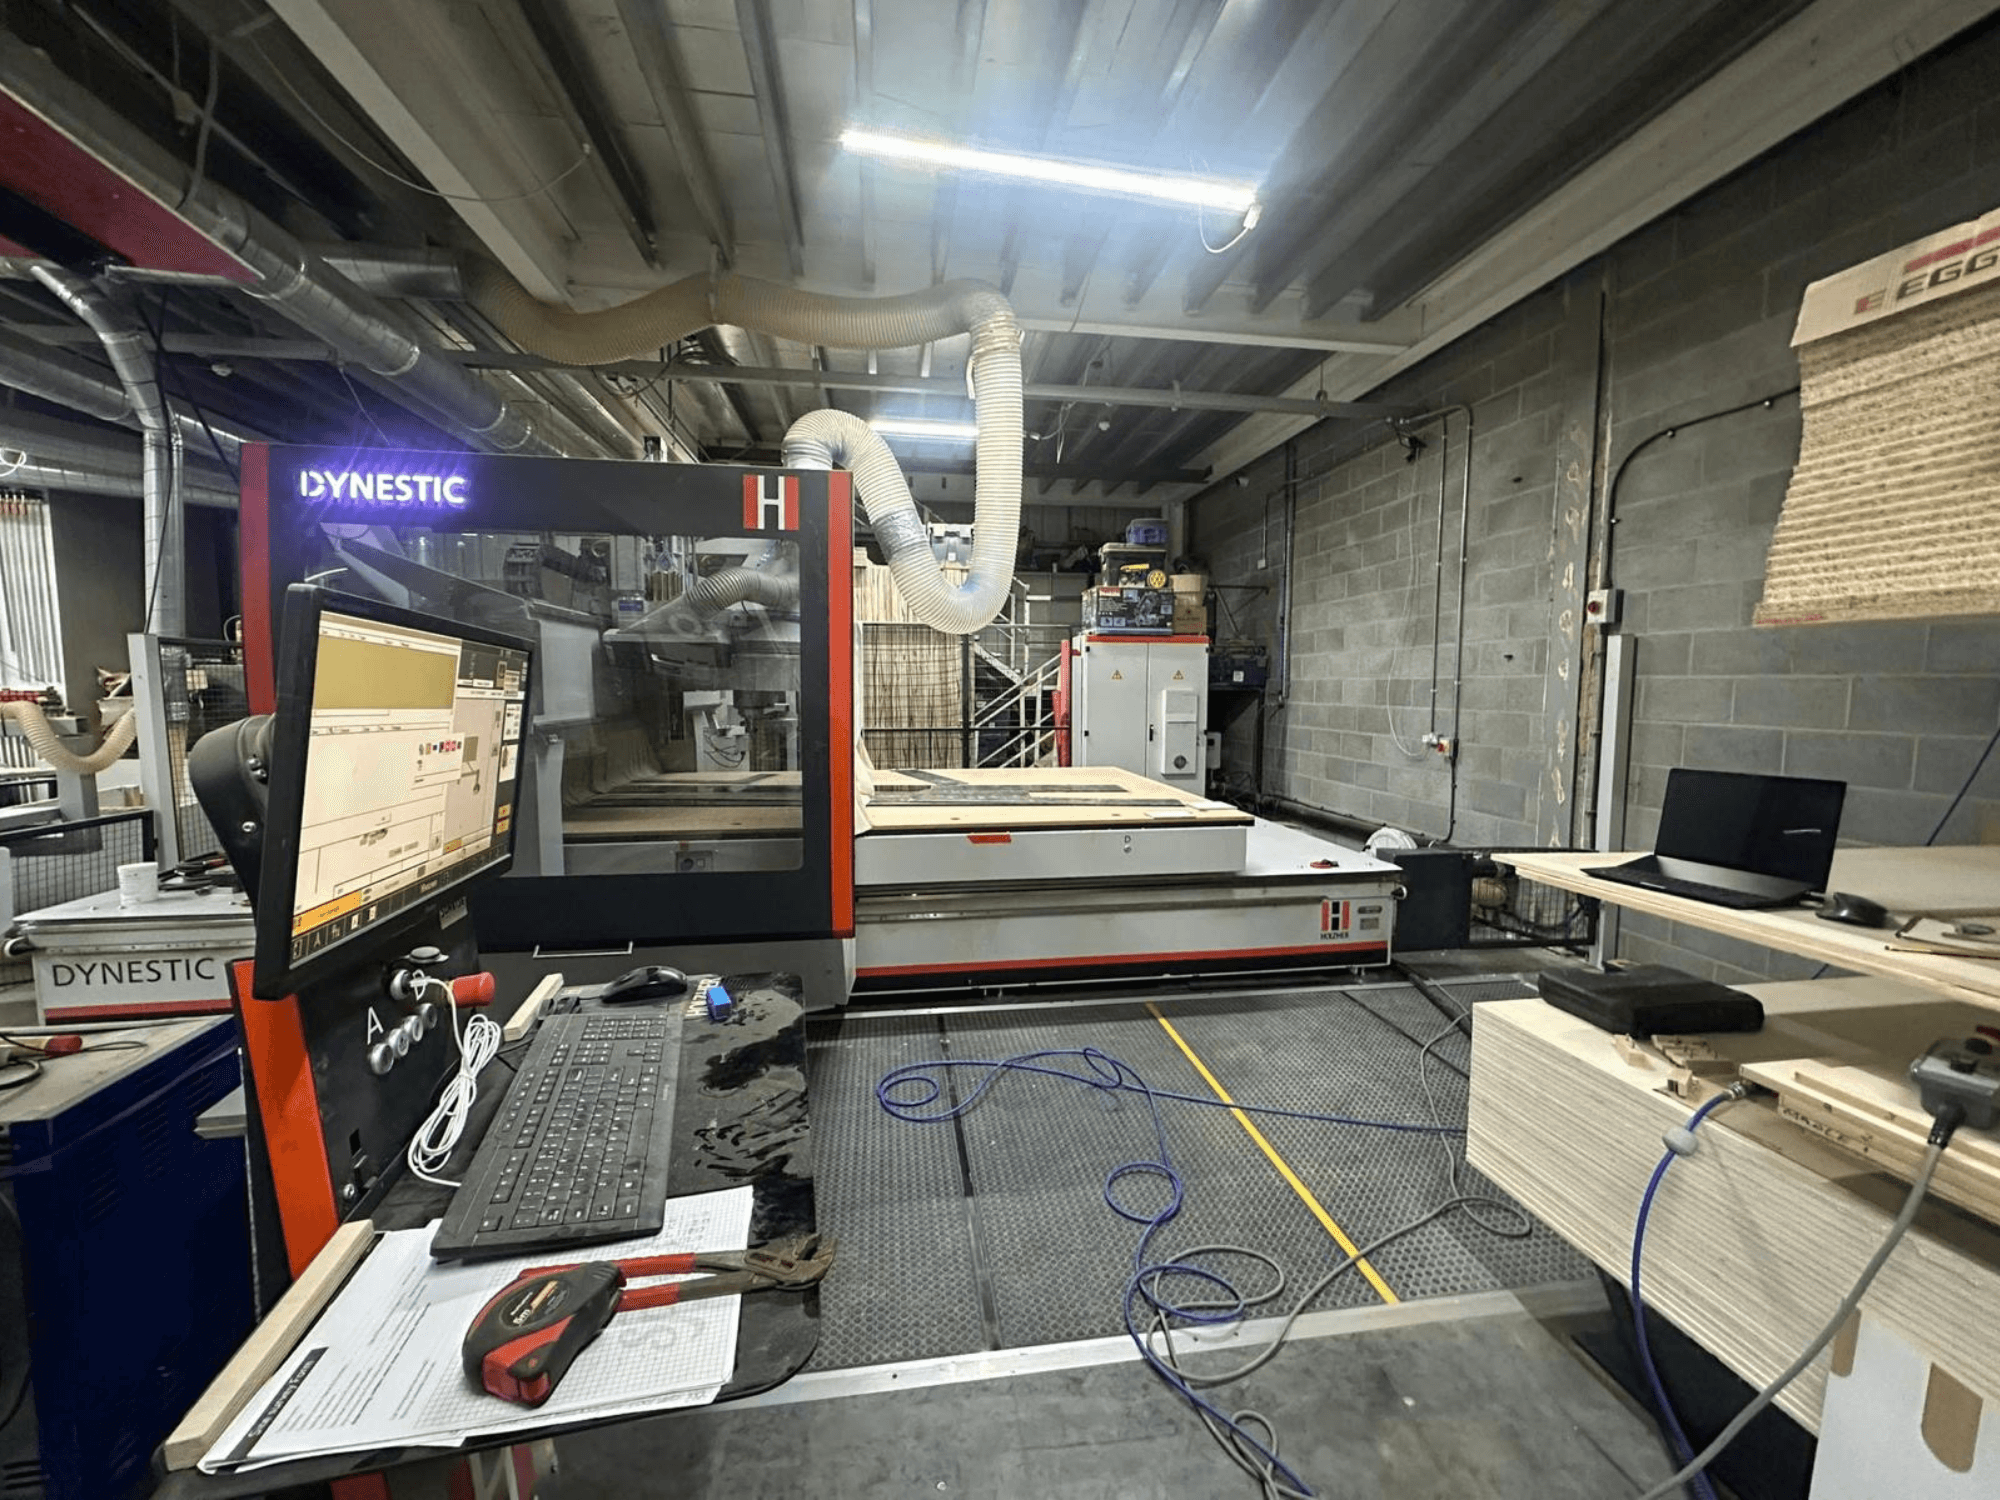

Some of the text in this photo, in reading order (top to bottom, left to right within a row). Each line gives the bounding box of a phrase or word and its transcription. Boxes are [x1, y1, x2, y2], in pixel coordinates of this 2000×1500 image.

[300, 470, 467, 504] DYNESTIC
[52, 957, 216, 987] DYNESTIC
[367, 1005, 384, 1046] A
